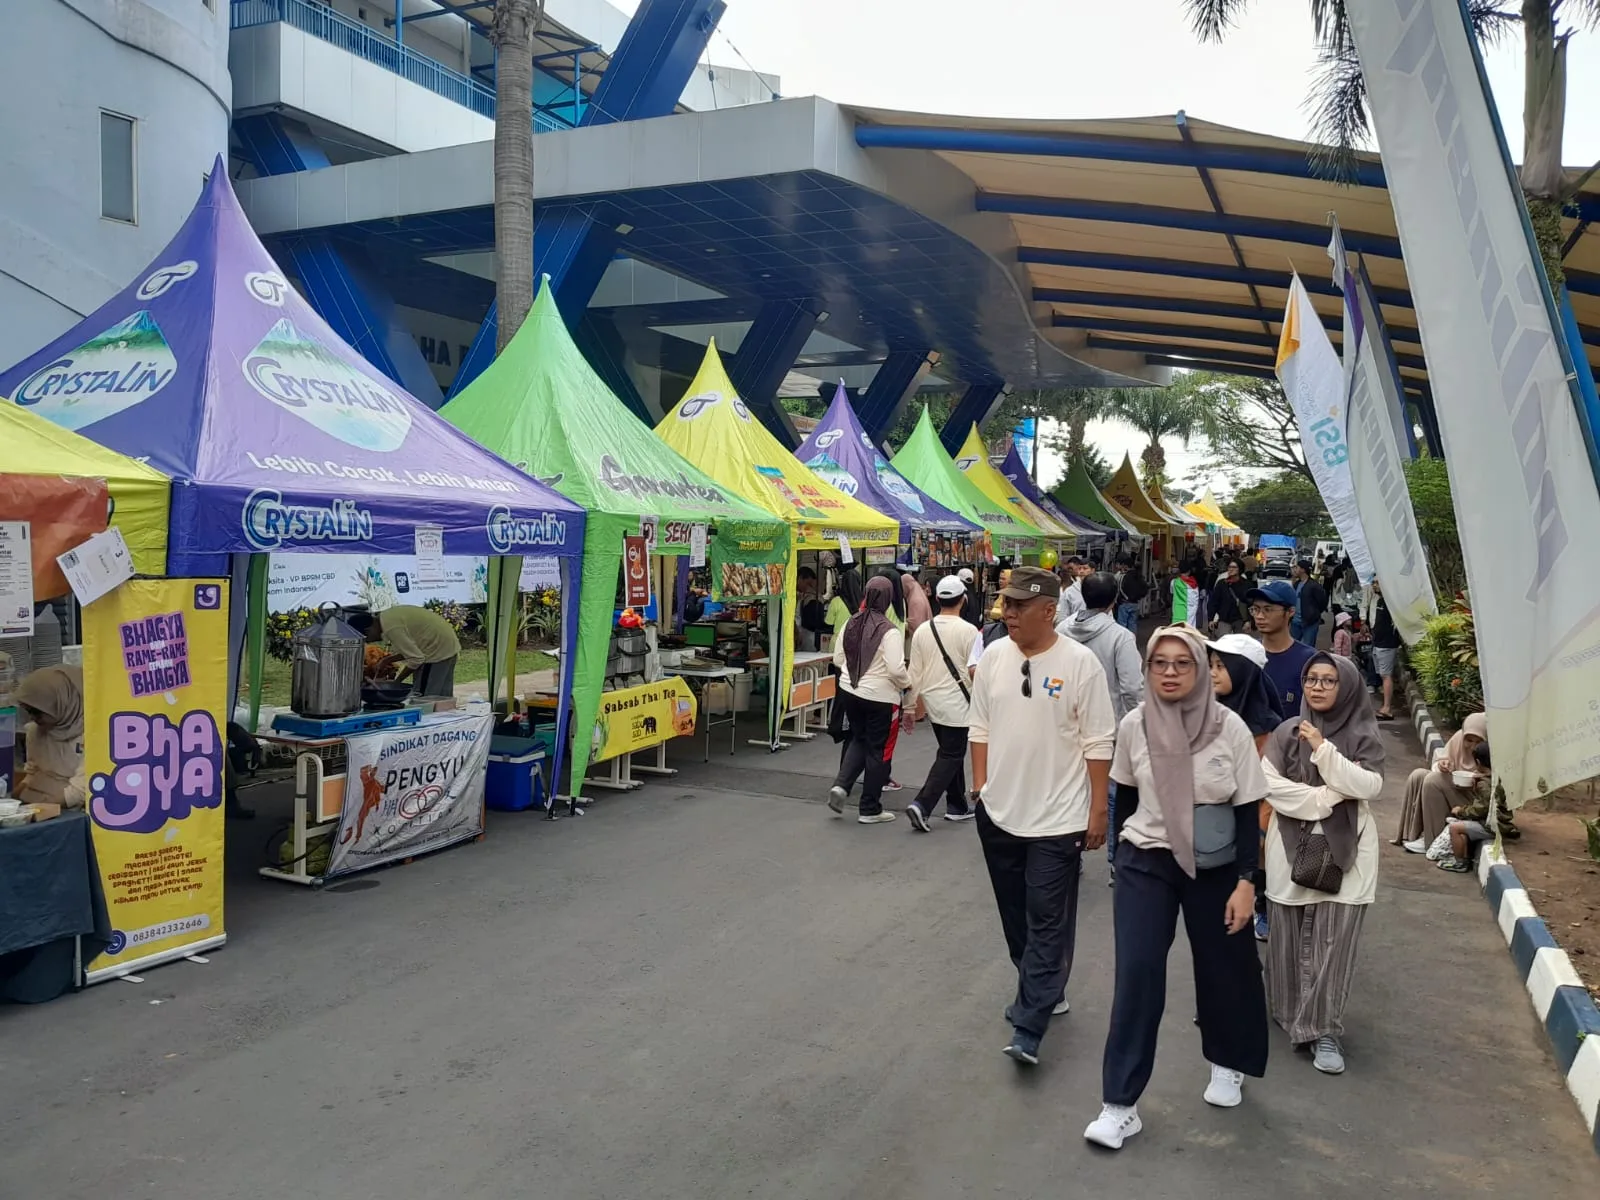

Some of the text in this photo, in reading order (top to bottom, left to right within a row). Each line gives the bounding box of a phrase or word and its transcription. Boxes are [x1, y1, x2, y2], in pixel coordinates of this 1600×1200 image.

[247, 452, 324, 475] Lebih
[404, 470, 463, 488] Lebih
[462, 475, 520, 492] Aman
[122, 613, 185, 647] BHAGYA
[126, 642, 186, 667] RAME-RAME
[132, 661, 189, 695] BHAGYA
[381, 730, 476, 760] SINDIKAT DAGANG
